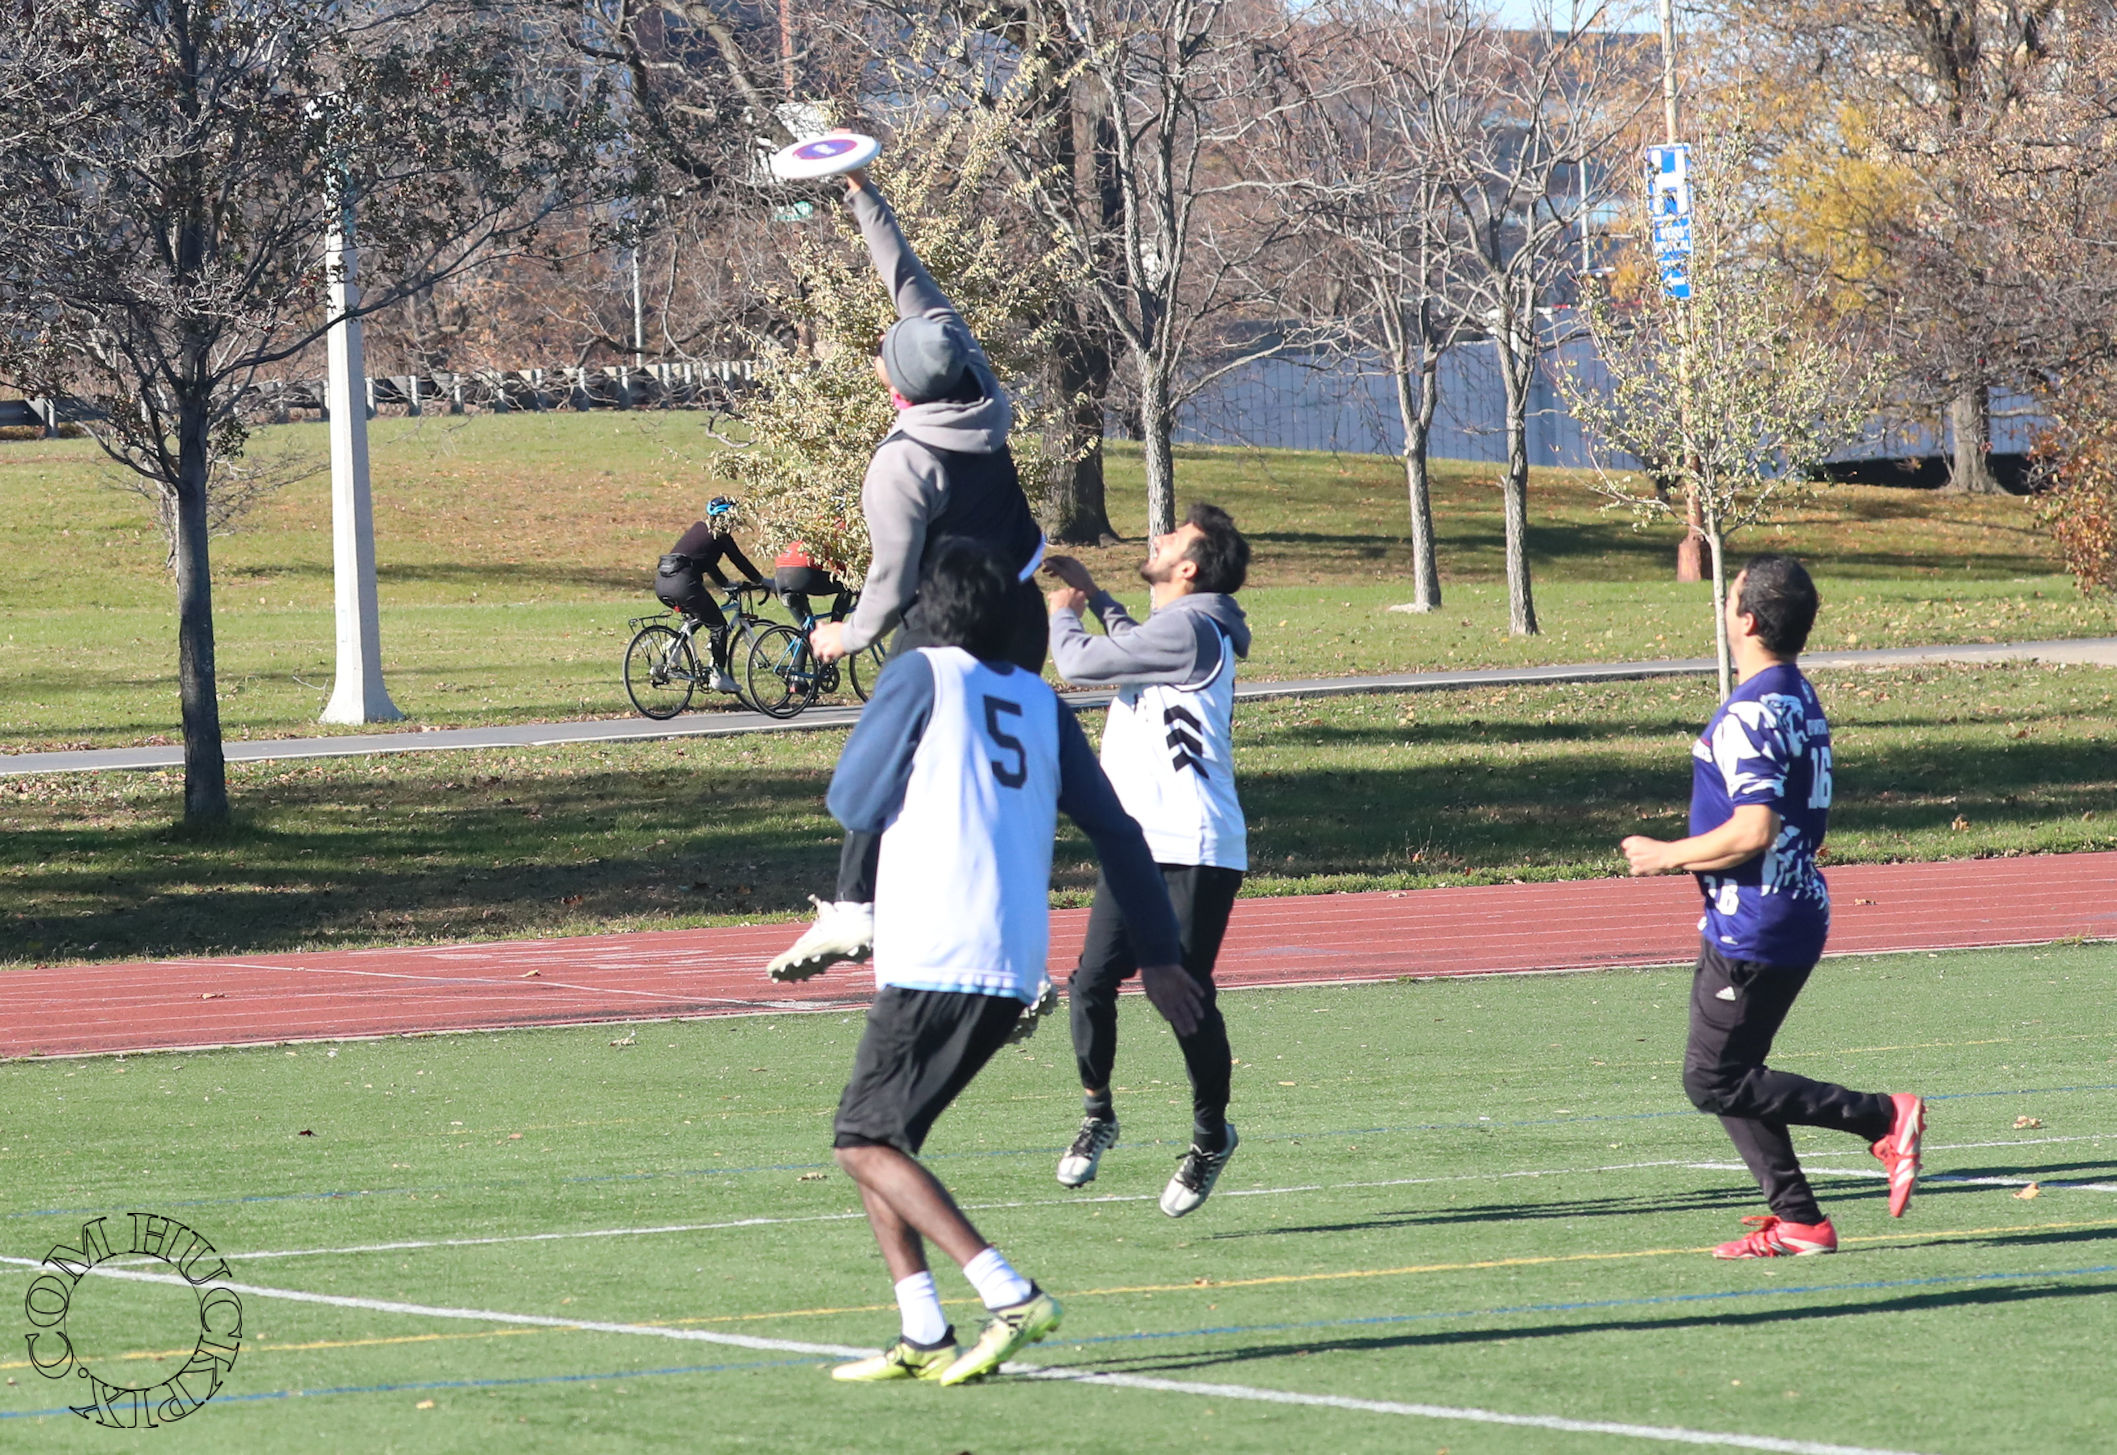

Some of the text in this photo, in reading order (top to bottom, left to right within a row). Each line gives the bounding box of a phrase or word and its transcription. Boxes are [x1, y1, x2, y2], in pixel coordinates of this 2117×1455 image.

[1651, 150, 1689, 215] H
[983, 694, 1028, 789] 5
[1809, 747, 1833, 809] 16
